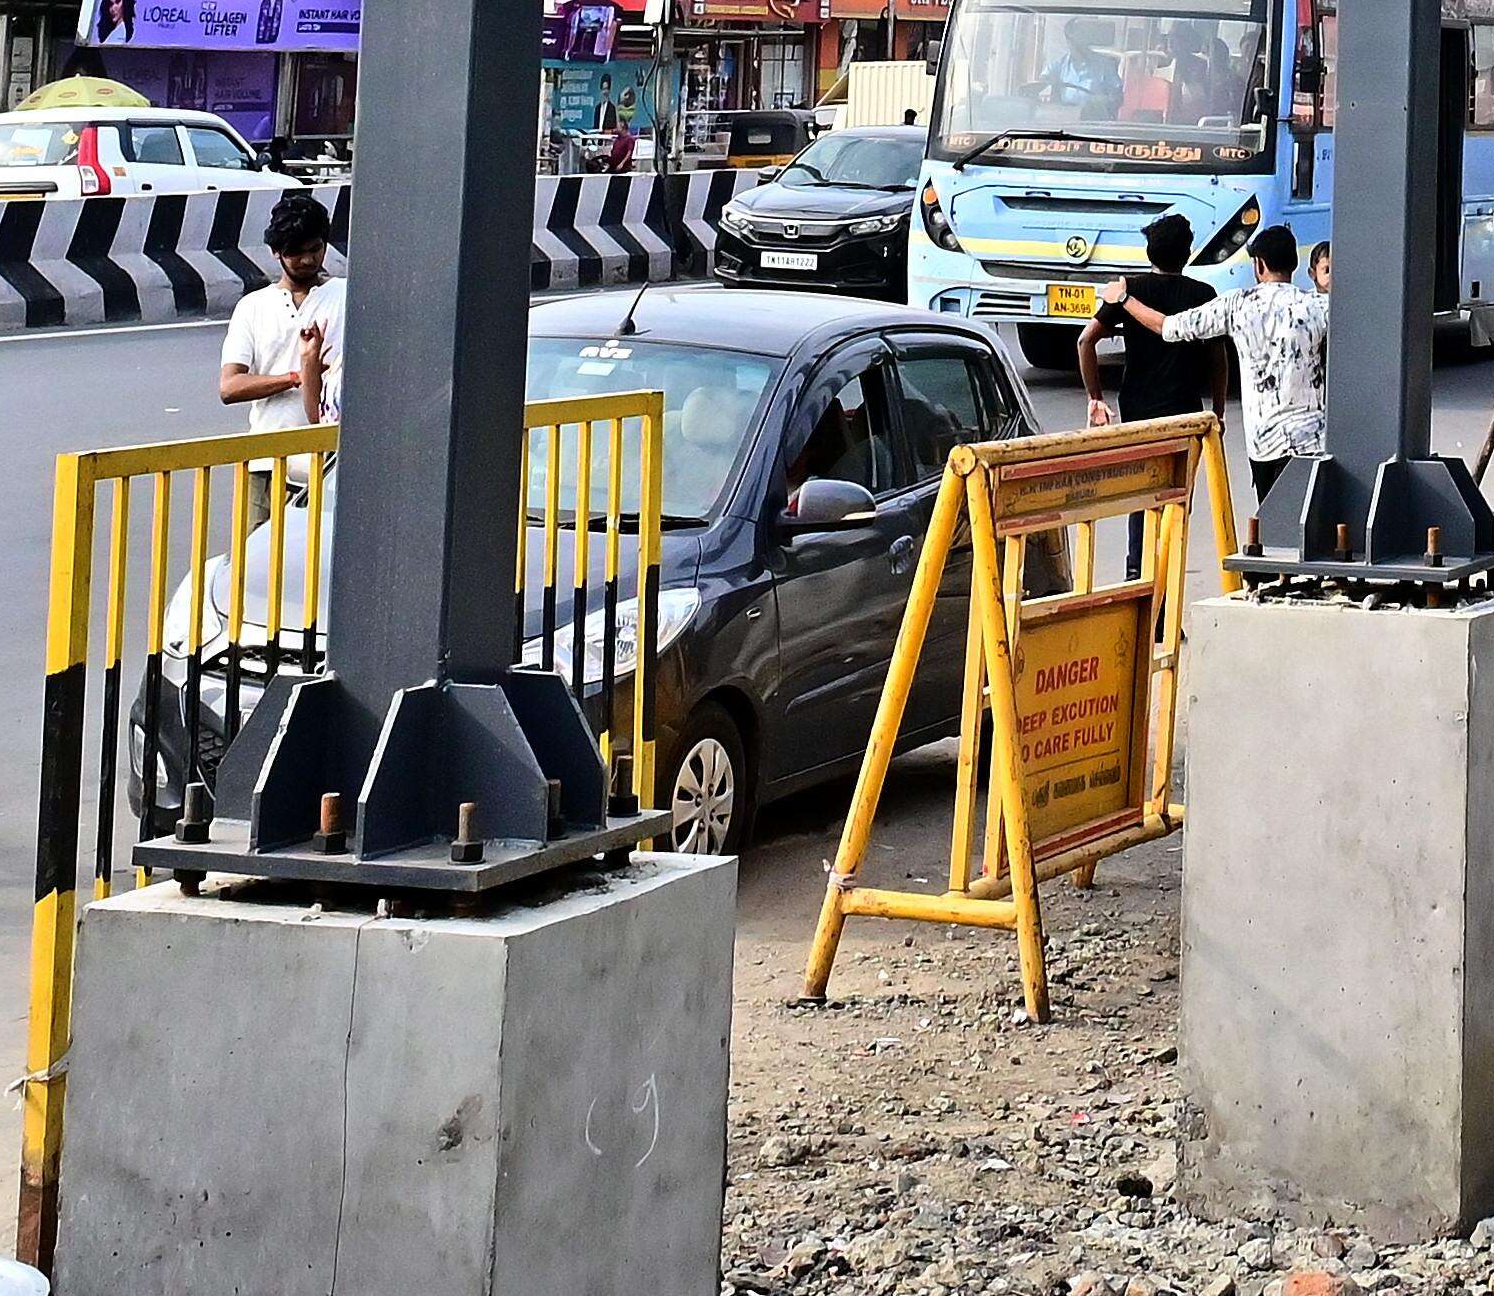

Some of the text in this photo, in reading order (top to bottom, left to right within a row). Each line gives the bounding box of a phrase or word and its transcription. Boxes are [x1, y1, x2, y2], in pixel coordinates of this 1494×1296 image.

[199, 11, 247, 24] COLLAGEN
[204, 25, 238, 36] LIFTER
[1219, 147, 1246, 159] MTC
[1058, 288, 1085, 298] TN-01
[1035, 656, 1100, 695] DANGER
[1051, 691, 1120, 726] EXCUTION
[1034, 732, 1070, 759] CARE
[1073, 721, 1115, 748] FULLY
